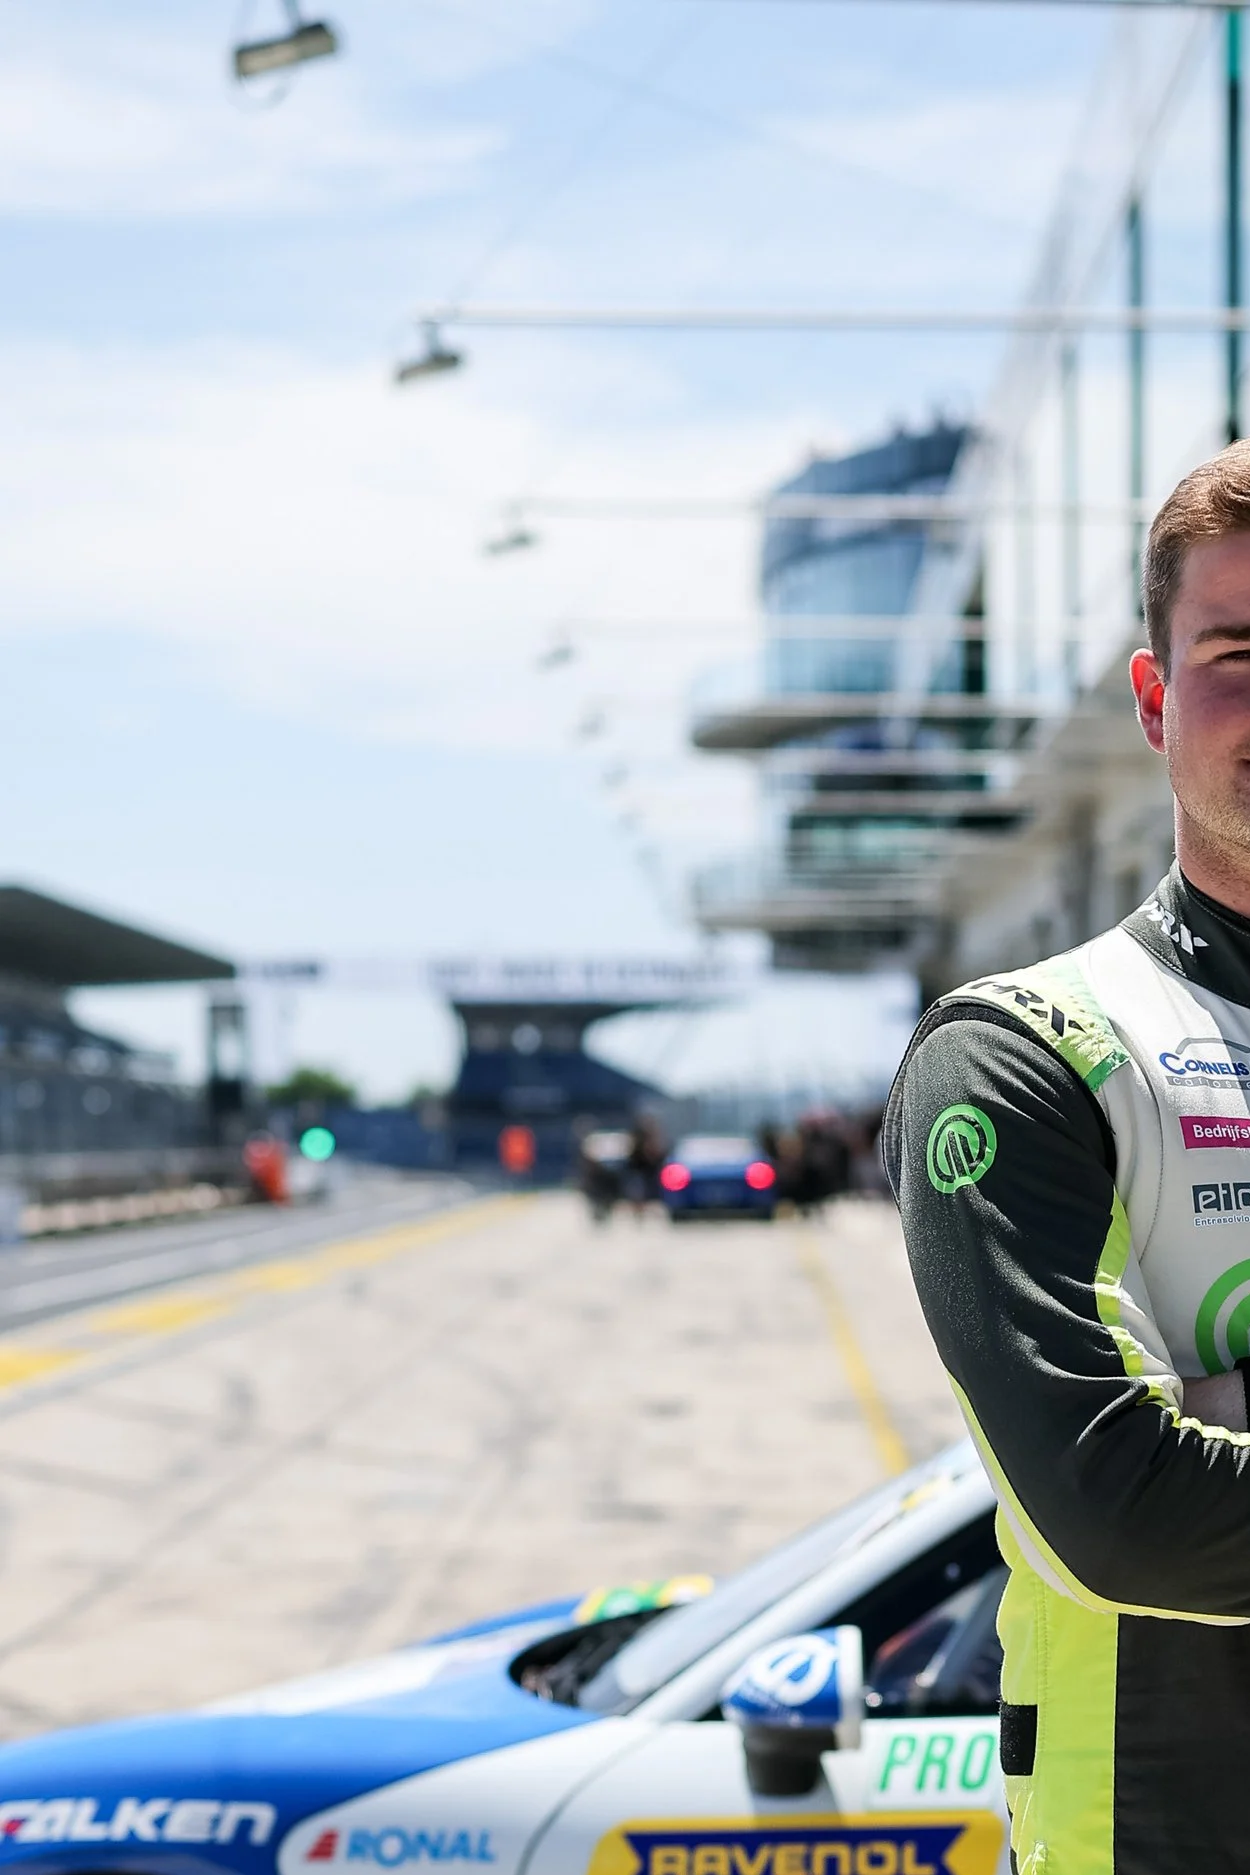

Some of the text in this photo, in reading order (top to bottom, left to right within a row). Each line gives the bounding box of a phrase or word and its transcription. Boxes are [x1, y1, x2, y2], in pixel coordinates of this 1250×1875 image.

[878, 1732, 998, 1792] PRO
[0, 1798, 277, 1846] FALKEN
[346, 1827, 497, 1868] RONAL
